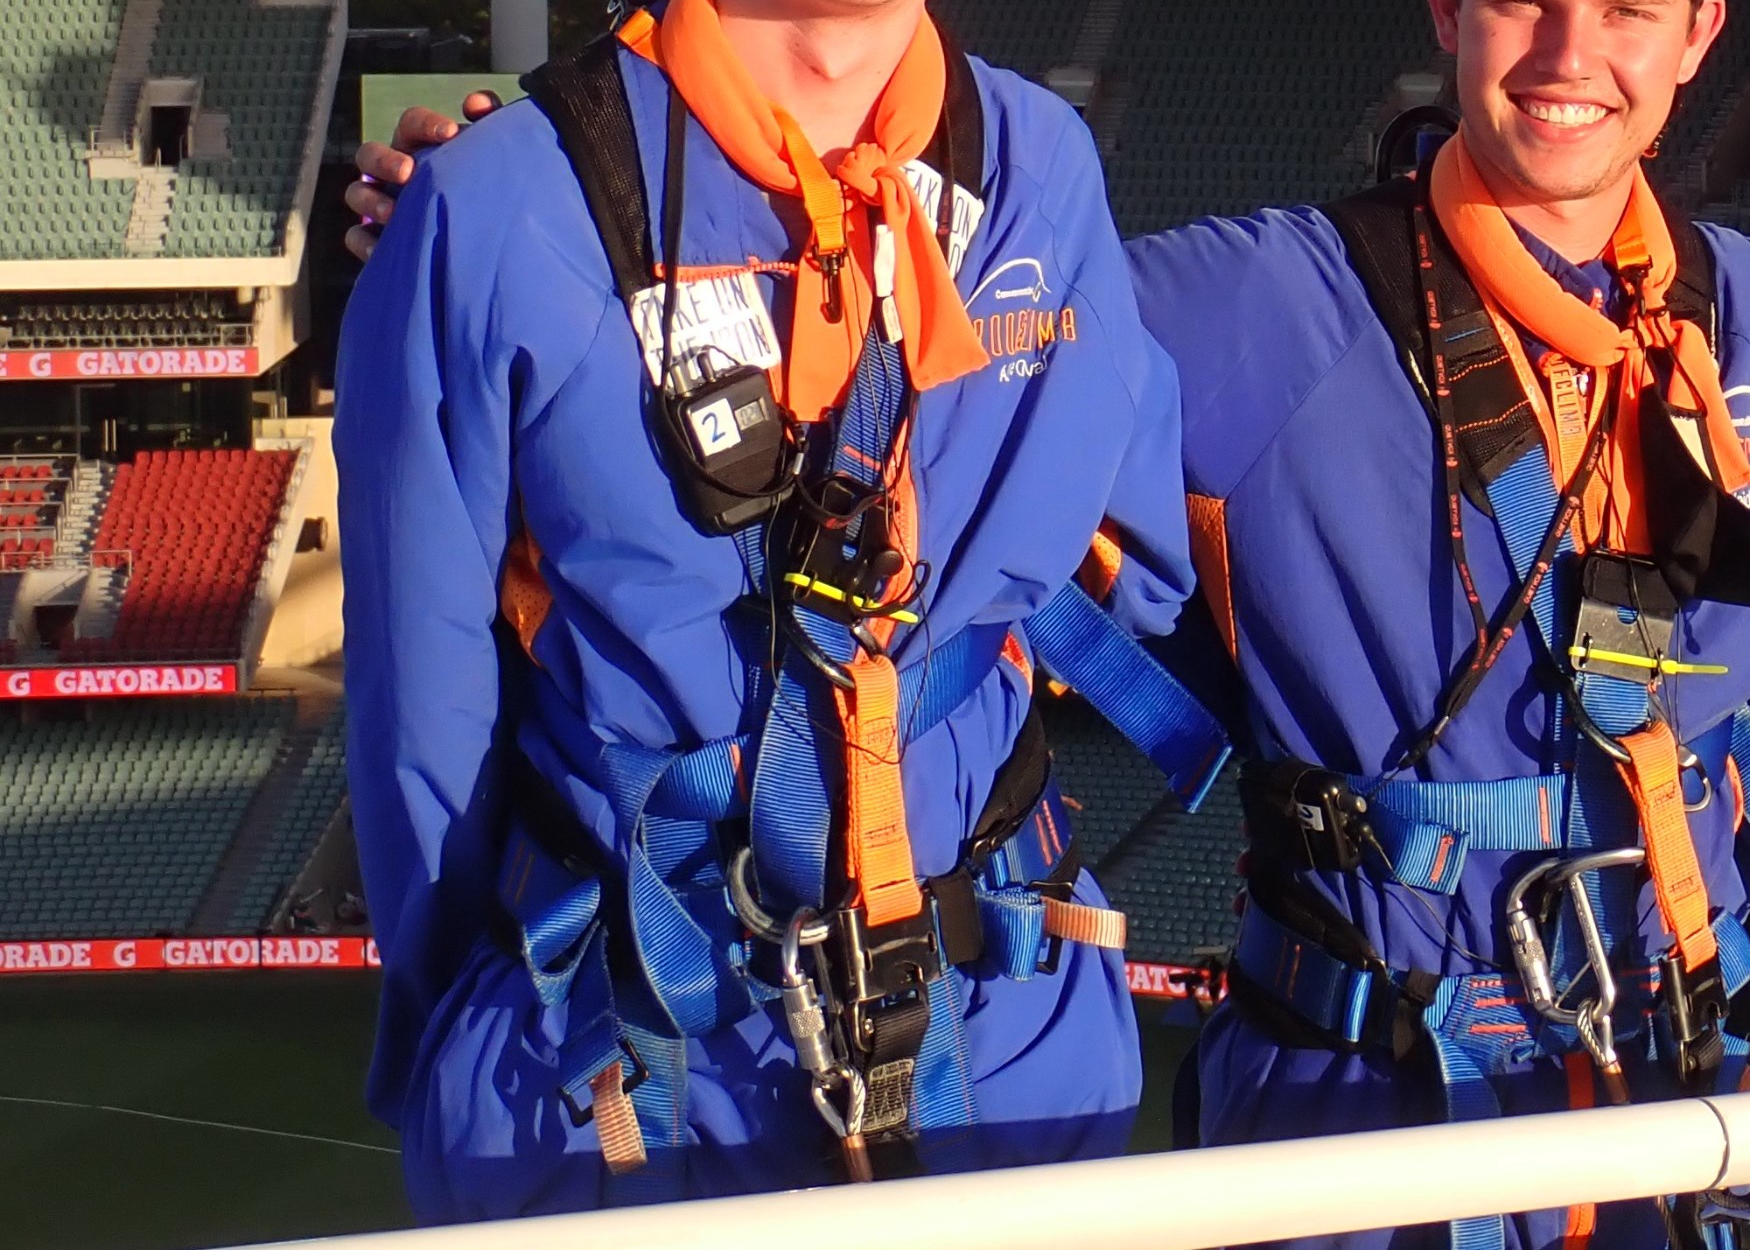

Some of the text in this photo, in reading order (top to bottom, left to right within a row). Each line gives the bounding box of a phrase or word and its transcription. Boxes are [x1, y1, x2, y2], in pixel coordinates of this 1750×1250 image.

[77, 350, 246, 375] GATORADE
[702, 412, 726, 443] 2
[55, 667, 223, 693] GATORADE
[0, 942, 92, 969] RADE
[163, 939, 340, 966] GATORADE
